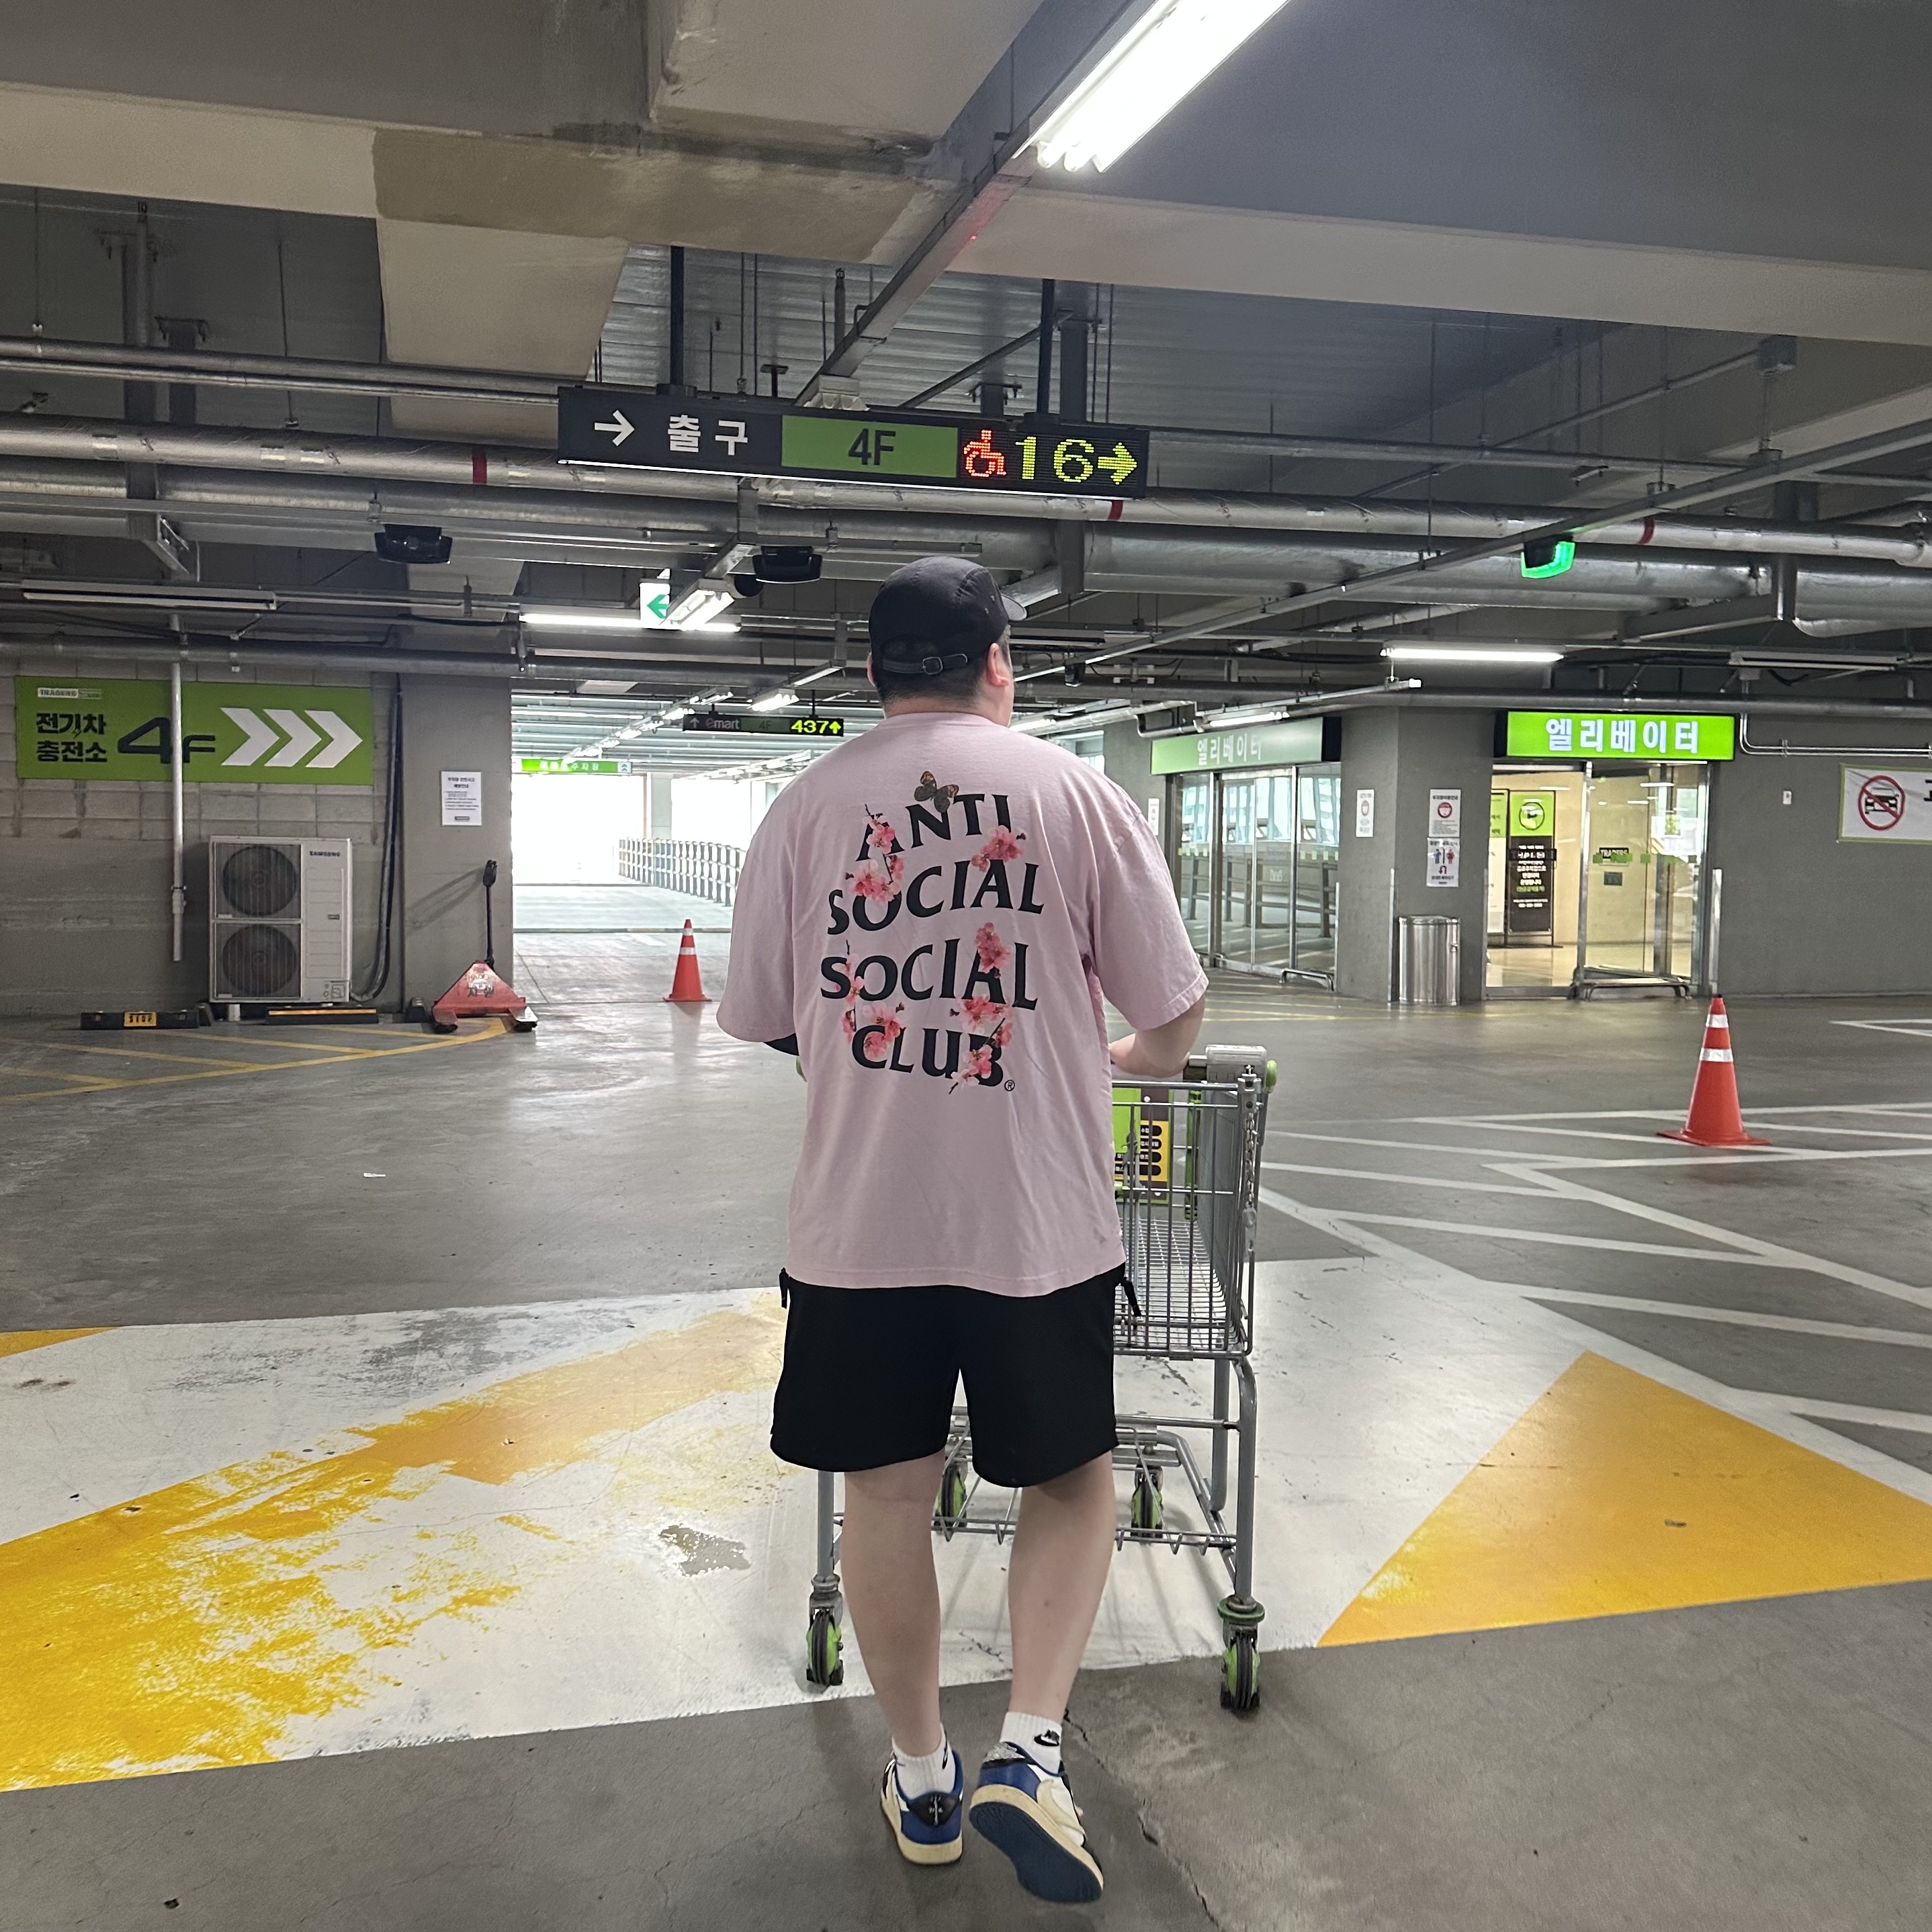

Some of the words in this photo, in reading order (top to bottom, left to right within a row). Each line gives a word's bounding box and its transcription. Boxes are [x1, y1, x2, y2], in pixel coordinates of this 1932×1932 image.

[668, 414, 748, 456] 출구
[848, 429, 895, 466] 4F
[1015, 435, 1094, 484] 16
[36, 713, 107, 736] 전기차
[118, 717, 216, 764] 4F
[706, 719, 740, 730] emart
[791, 719, 830, 734] 437
[1545, 718, 1699, 754] 엘리베이터
[36, 740, 107, 762] 충전소
[1197, 732, 1261, 766] 엘리베이터
[855, 794, 1012, 861] ANTI
[827, 859, 1045, 934] SOCIAL
[820, 938, 1039, 1011] SOCIAL
